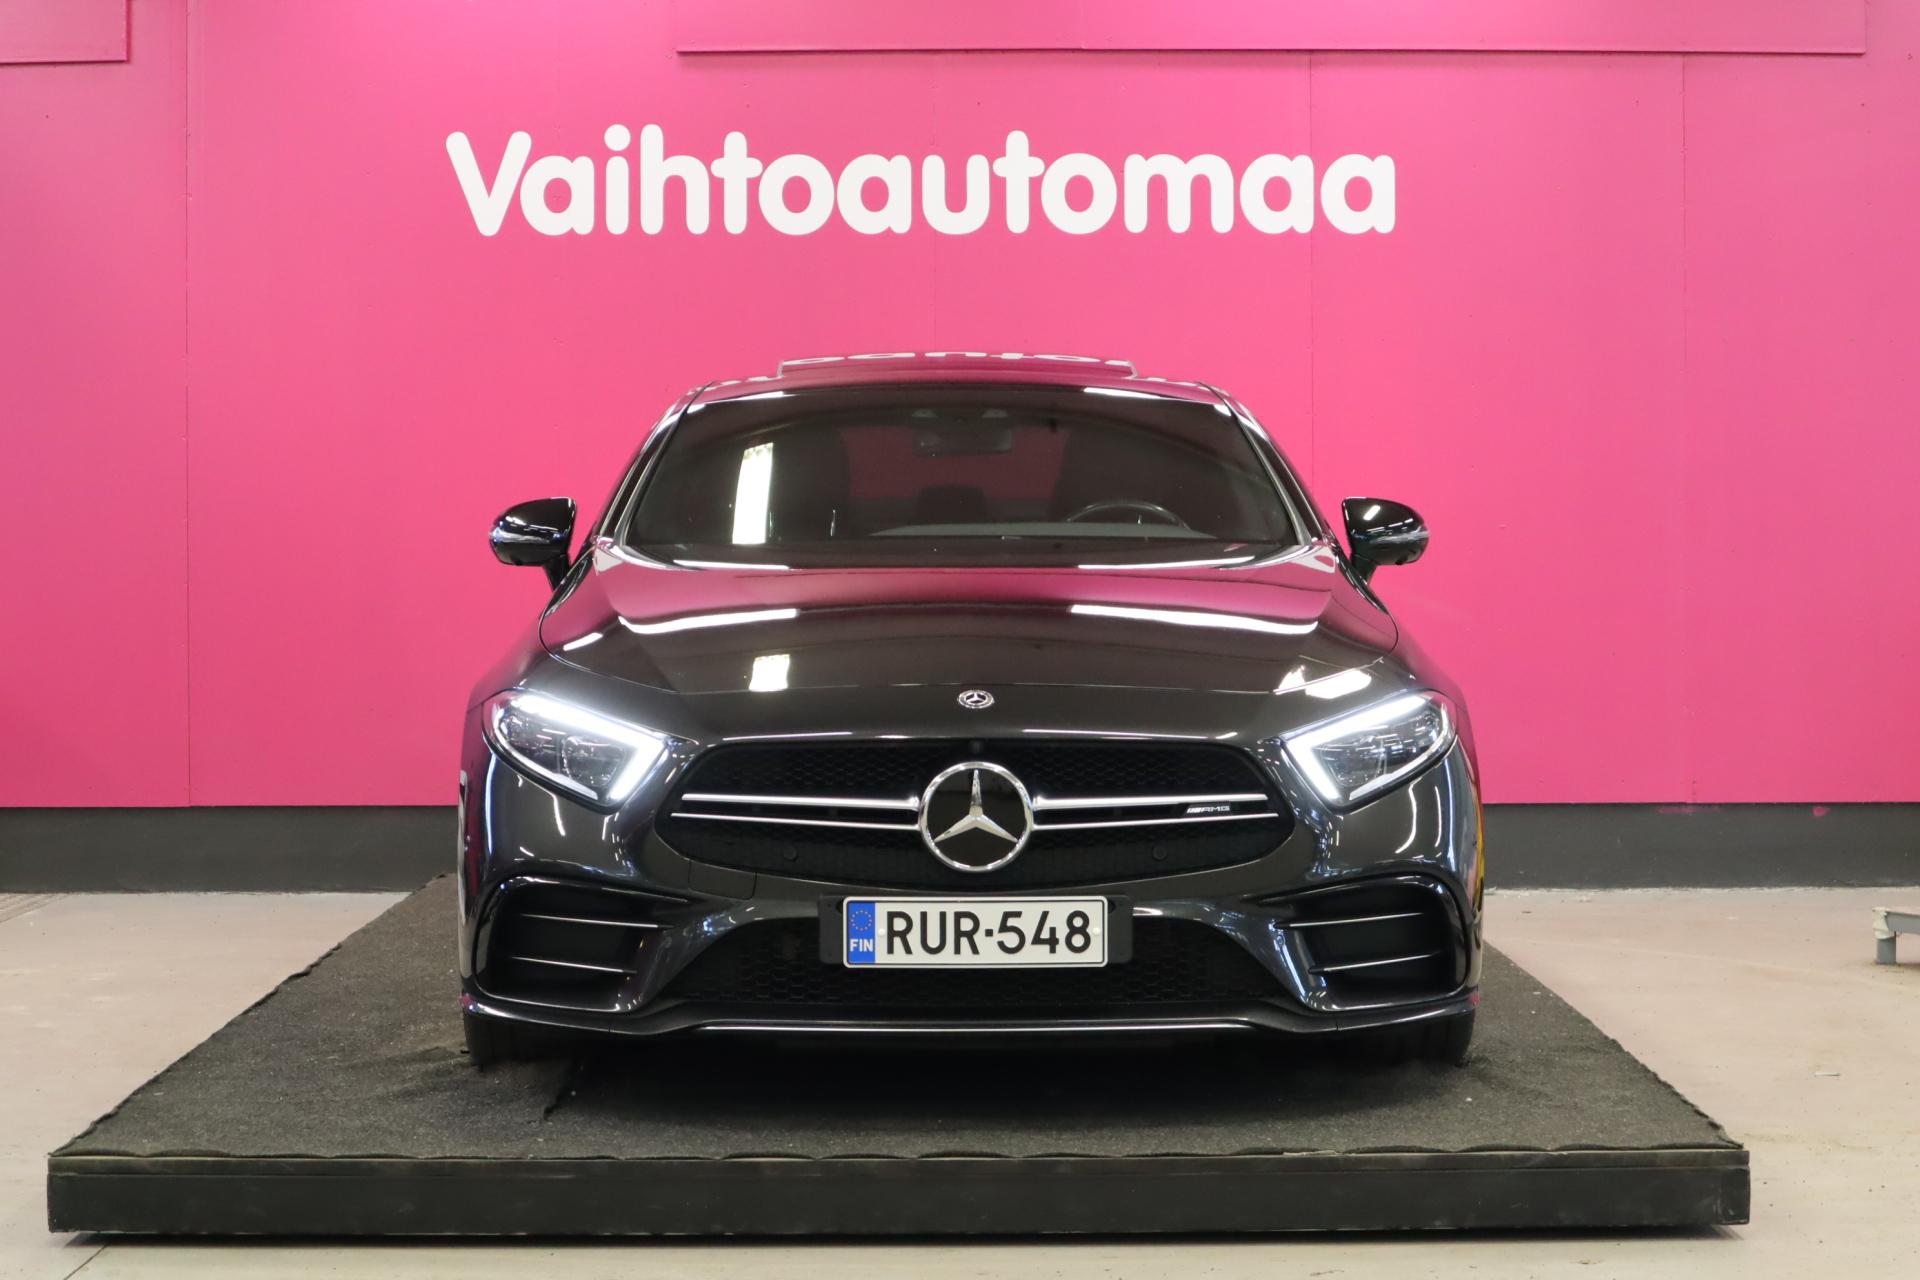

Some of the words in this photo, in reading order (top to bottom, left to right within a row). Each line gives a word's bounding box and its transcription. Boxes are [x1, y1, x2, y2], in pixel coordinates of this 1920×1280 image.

[445, 124, 1396, 237] Vaihtoautomaa
[849, 938, 873, 953] FIN
[886, 909, 1091, 955] RUR-548
